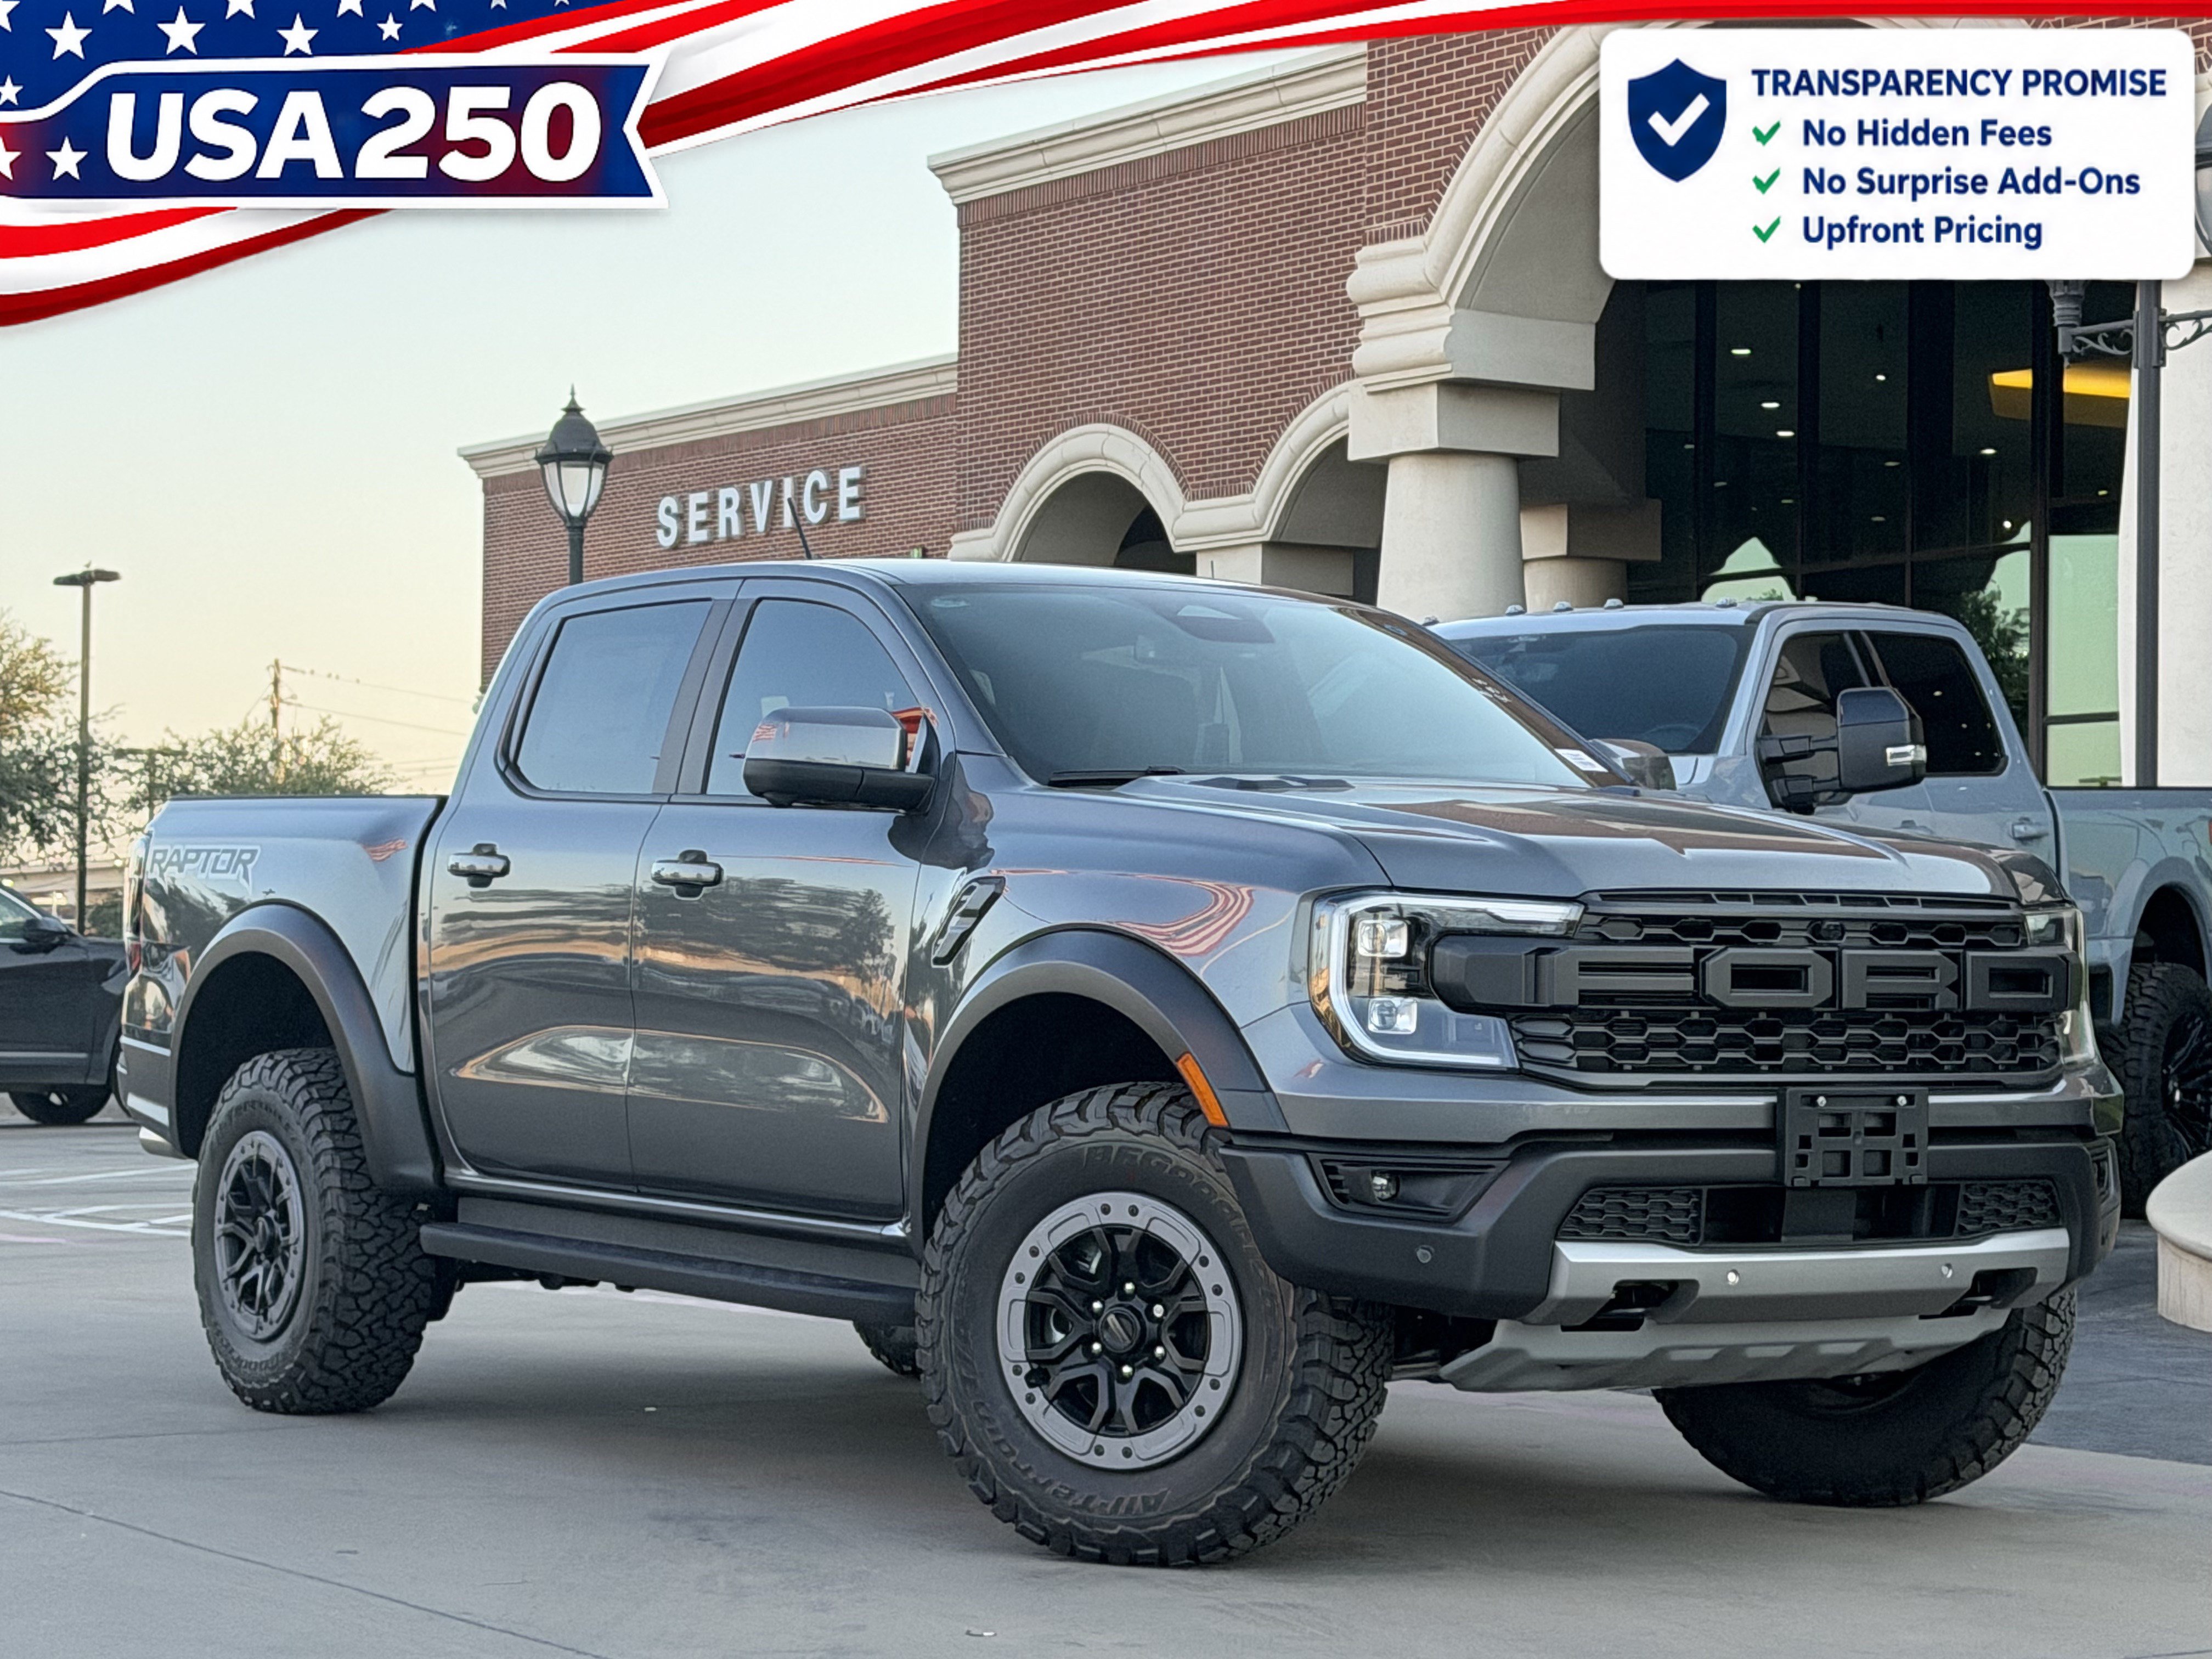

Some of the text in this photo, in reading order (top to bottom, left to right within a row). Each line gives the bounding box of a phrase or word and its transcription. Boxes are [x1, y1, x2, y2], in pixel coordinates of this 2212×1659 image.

[657, 466, 865, 548] SERVICE
[147, 845, 261, 895] RAPTOR
[1538, 945, 2073, 1011] FORD
